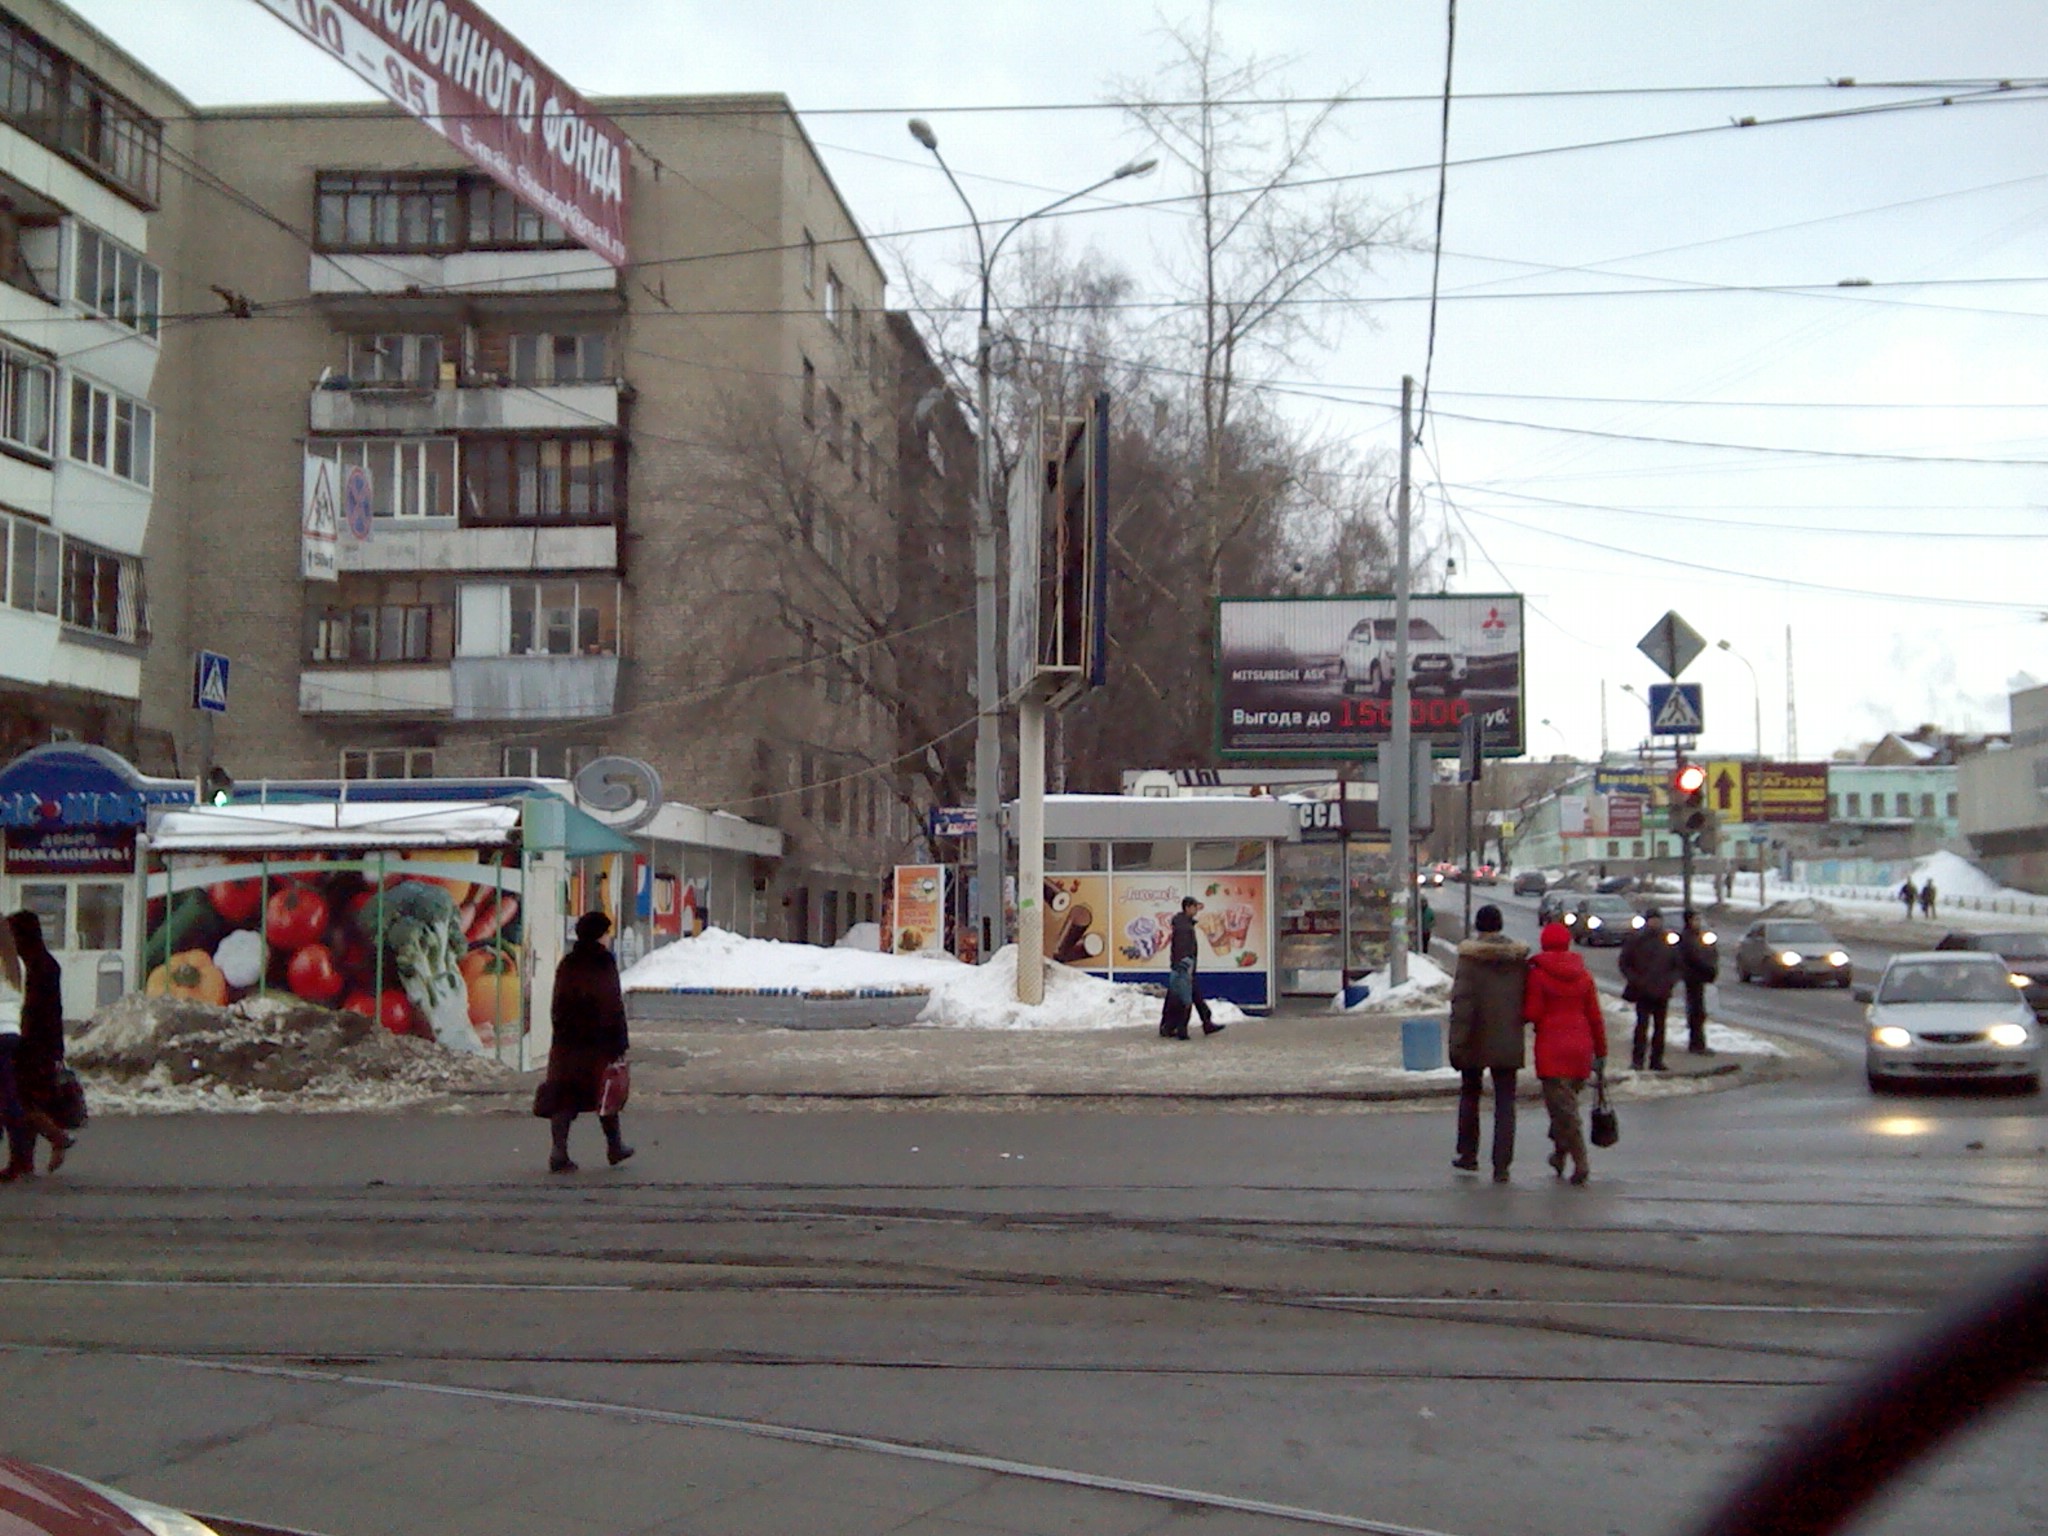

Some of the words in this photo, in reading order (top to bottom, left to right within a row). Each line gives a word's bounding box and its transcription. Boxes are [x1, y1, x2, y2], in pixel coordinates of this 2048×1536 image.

[541, 92, 622, 204] ФОНДА
[1232, 669, 1300, 681] MITSUBISHI
[1303, 669, 1326, 680] ASX
[1232, 708, 1303, 728] Выгода
[1306, 710, 1331, 727] до
